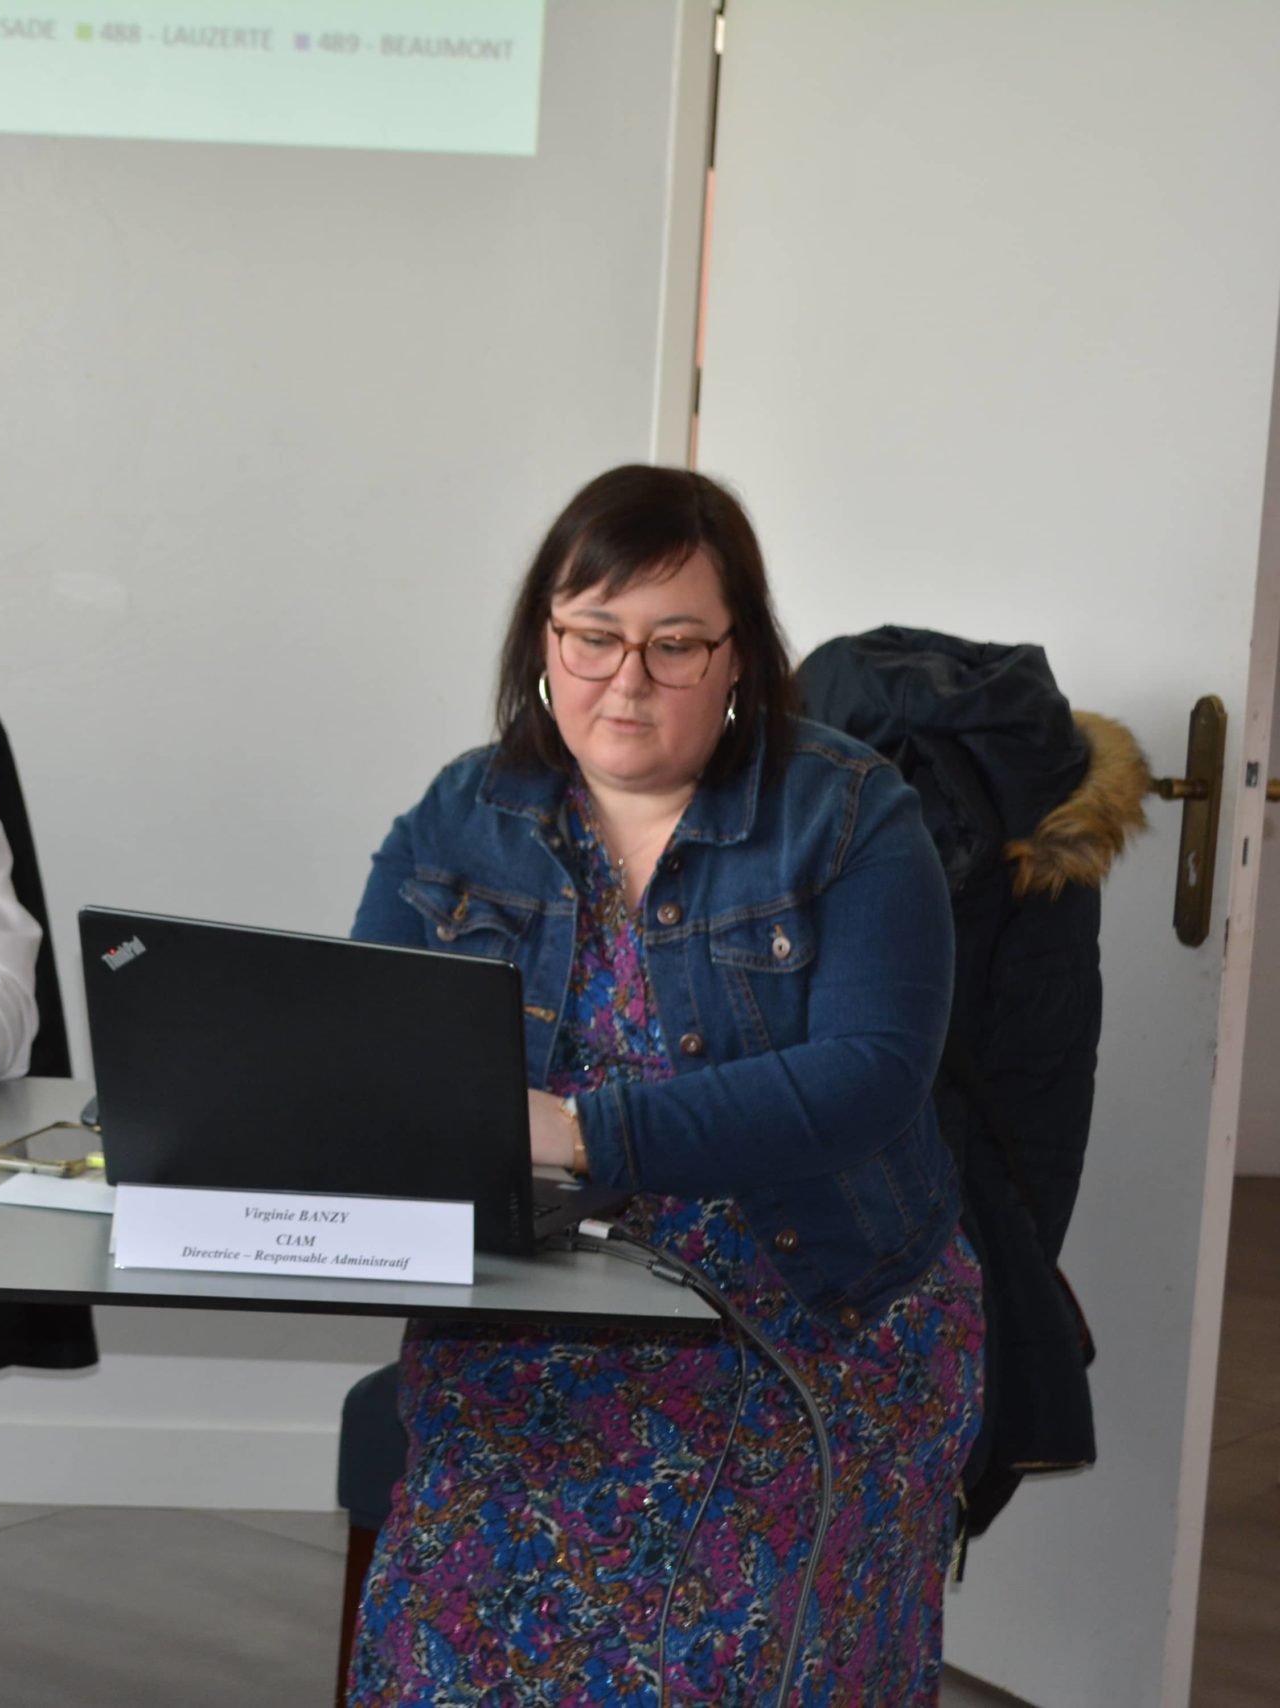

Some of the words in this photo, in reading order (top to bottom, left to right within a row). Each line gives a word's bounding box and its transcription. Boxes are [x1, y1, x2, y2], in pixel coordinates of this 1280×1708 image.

[163, 25, 273, 51] LAUZERTE
[380, 34, 514, 60] BEAUMONT
[245, 1207, 295, 1222] Virginie
[299, 1210, 349, 1223] BANZY
[276, 1234, 316, 1247] CIAM
[182, 1246, 240, 1259] Directrice
[254, 1250, 327, 1266] Responsable
[331, 1254, 410, 1271] Administratif
